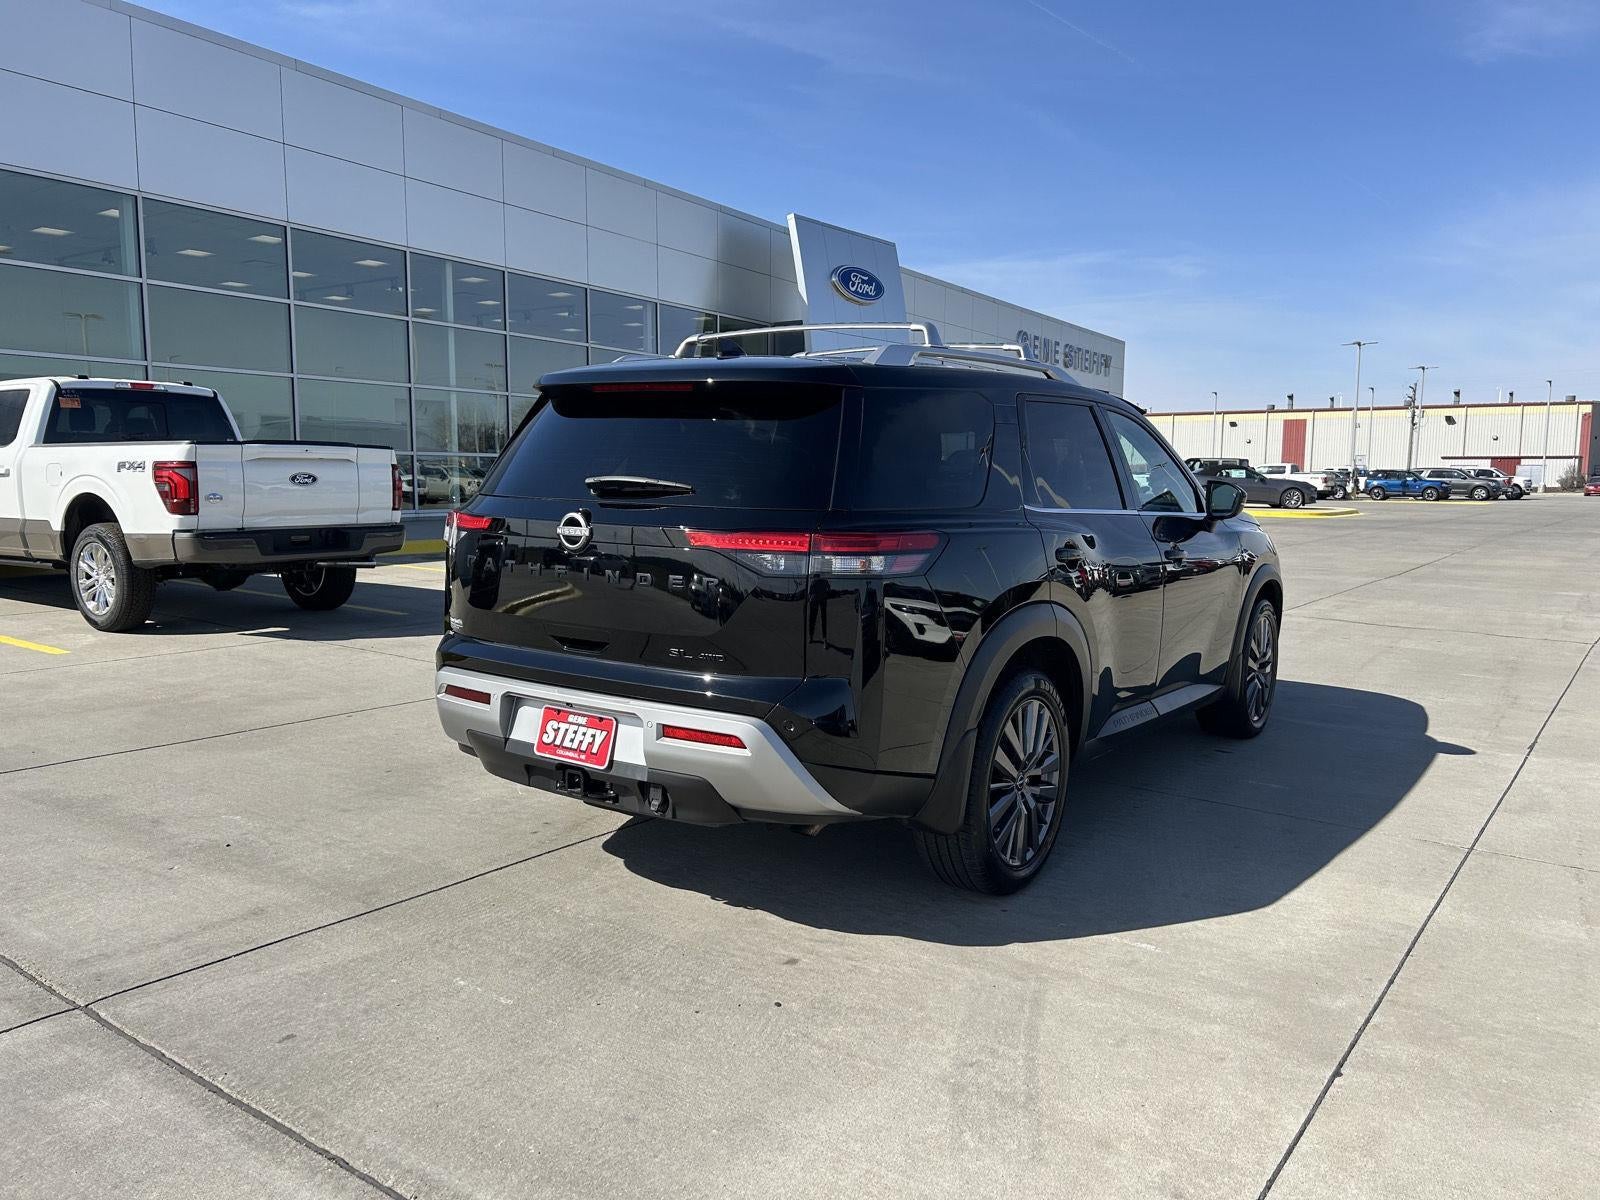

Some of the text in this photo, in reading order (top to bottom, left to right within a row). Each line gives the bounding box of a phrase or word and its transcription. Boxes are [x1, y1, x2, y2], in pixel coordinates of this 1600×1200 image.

[849, 272, 877, 296] Ford
[1063, 343, 1113, 377] STEFFY
[117, 461, 146, 473] FX4
[556, 526, 590, 537] NISSAN
[567, 714, 589, 725] GENE
[541, 719, 609, 755] STEFFY
